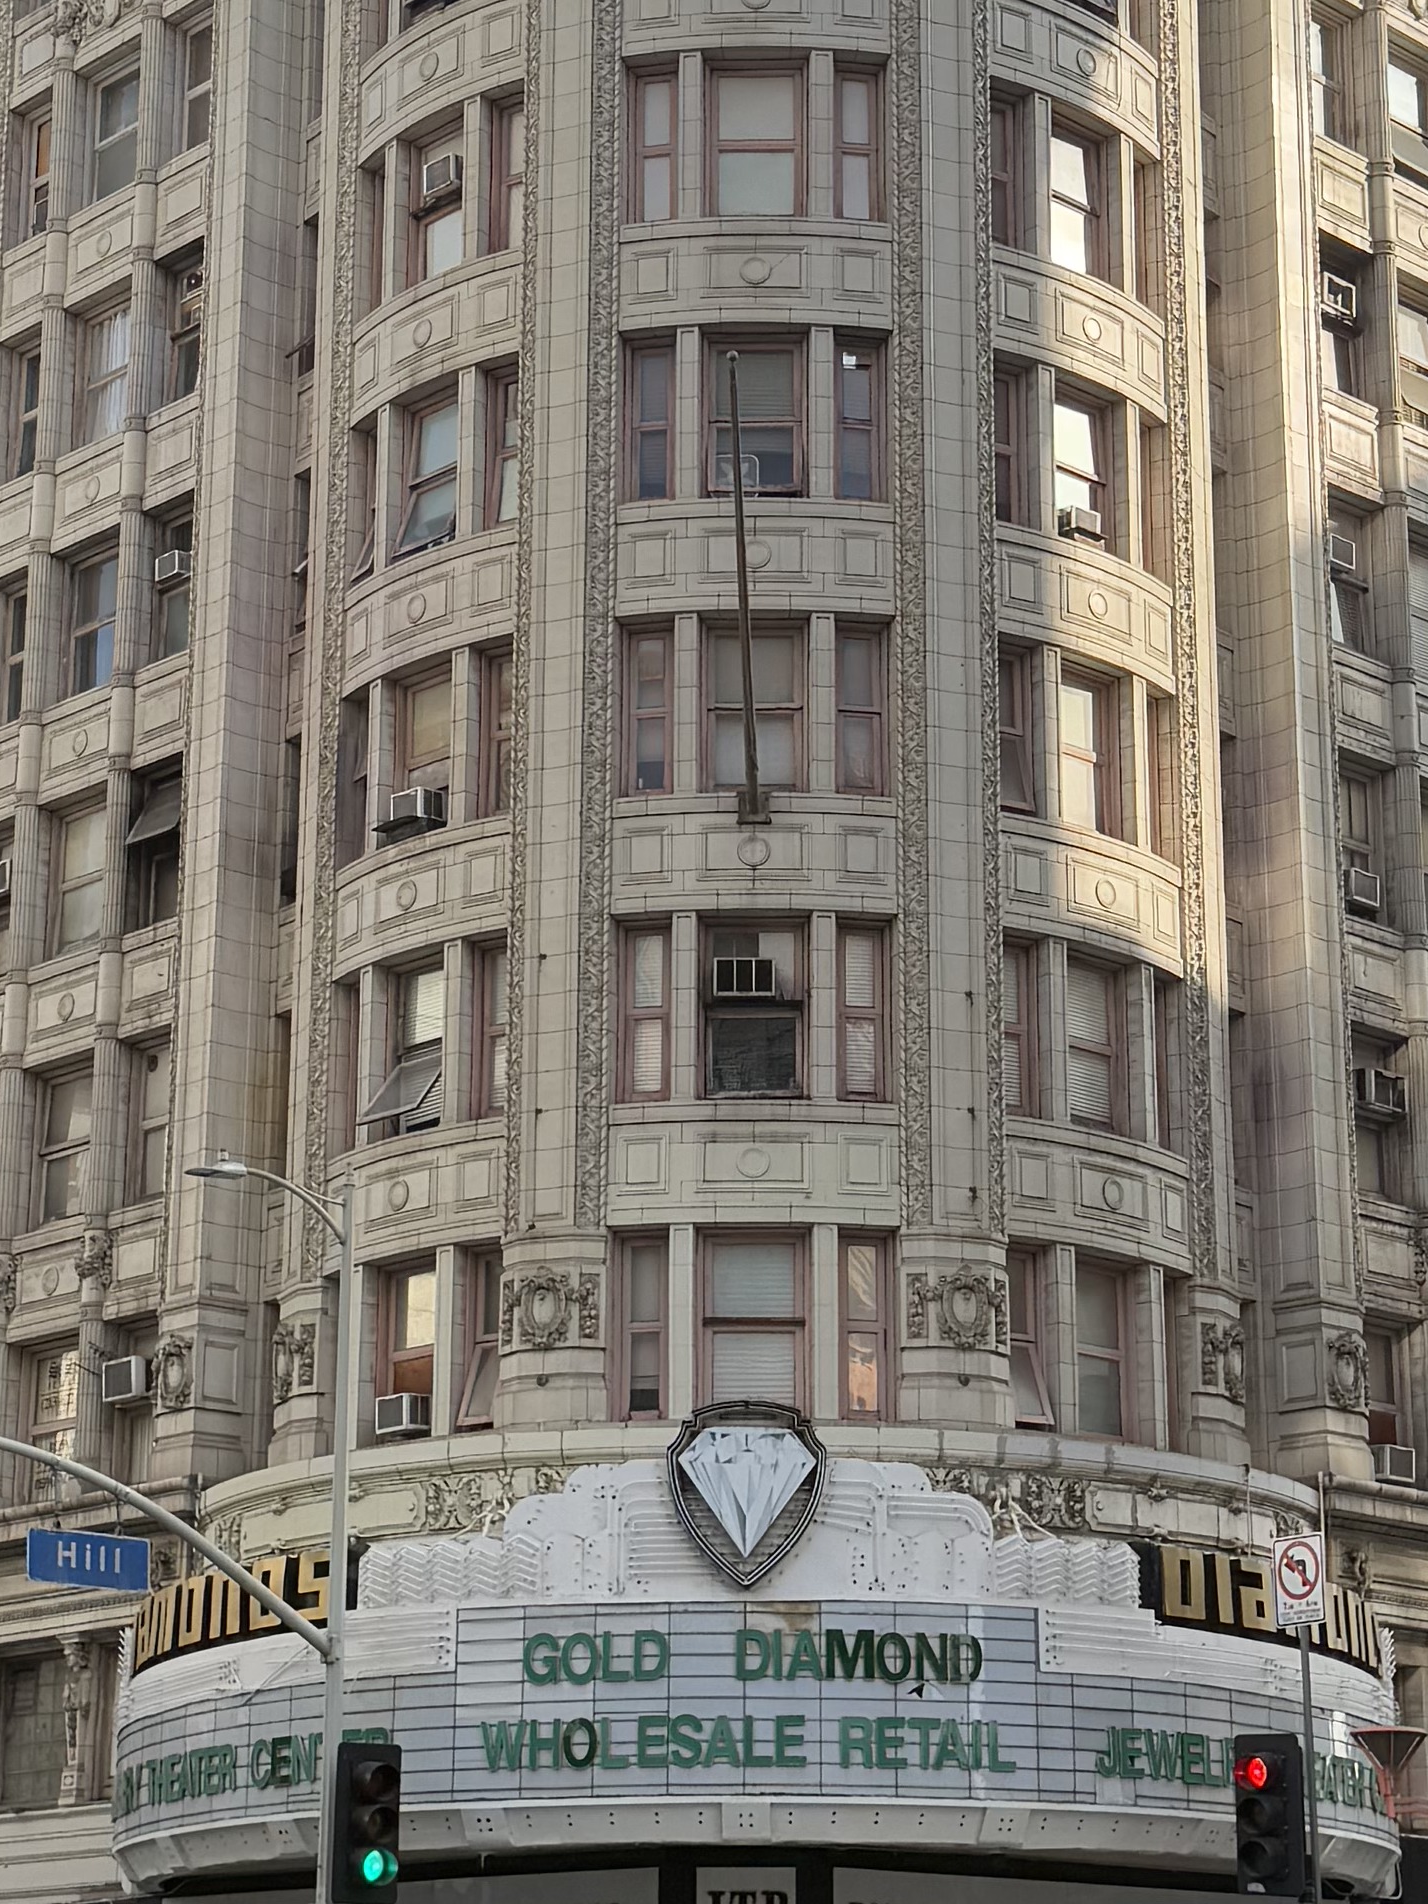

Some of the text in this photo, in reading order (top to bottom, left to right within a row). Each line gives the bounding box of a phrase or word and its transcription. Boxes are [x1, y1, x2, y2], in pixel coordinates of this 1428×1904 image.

[57, 1540, 121, 1574] Hill
[522, 1627, 983, 1685] GOLD DIAMOND
[480, 1714, 1017, 1774] WHOLESALE RETAIL
[146, 1744, 238, 1807] THEATER
